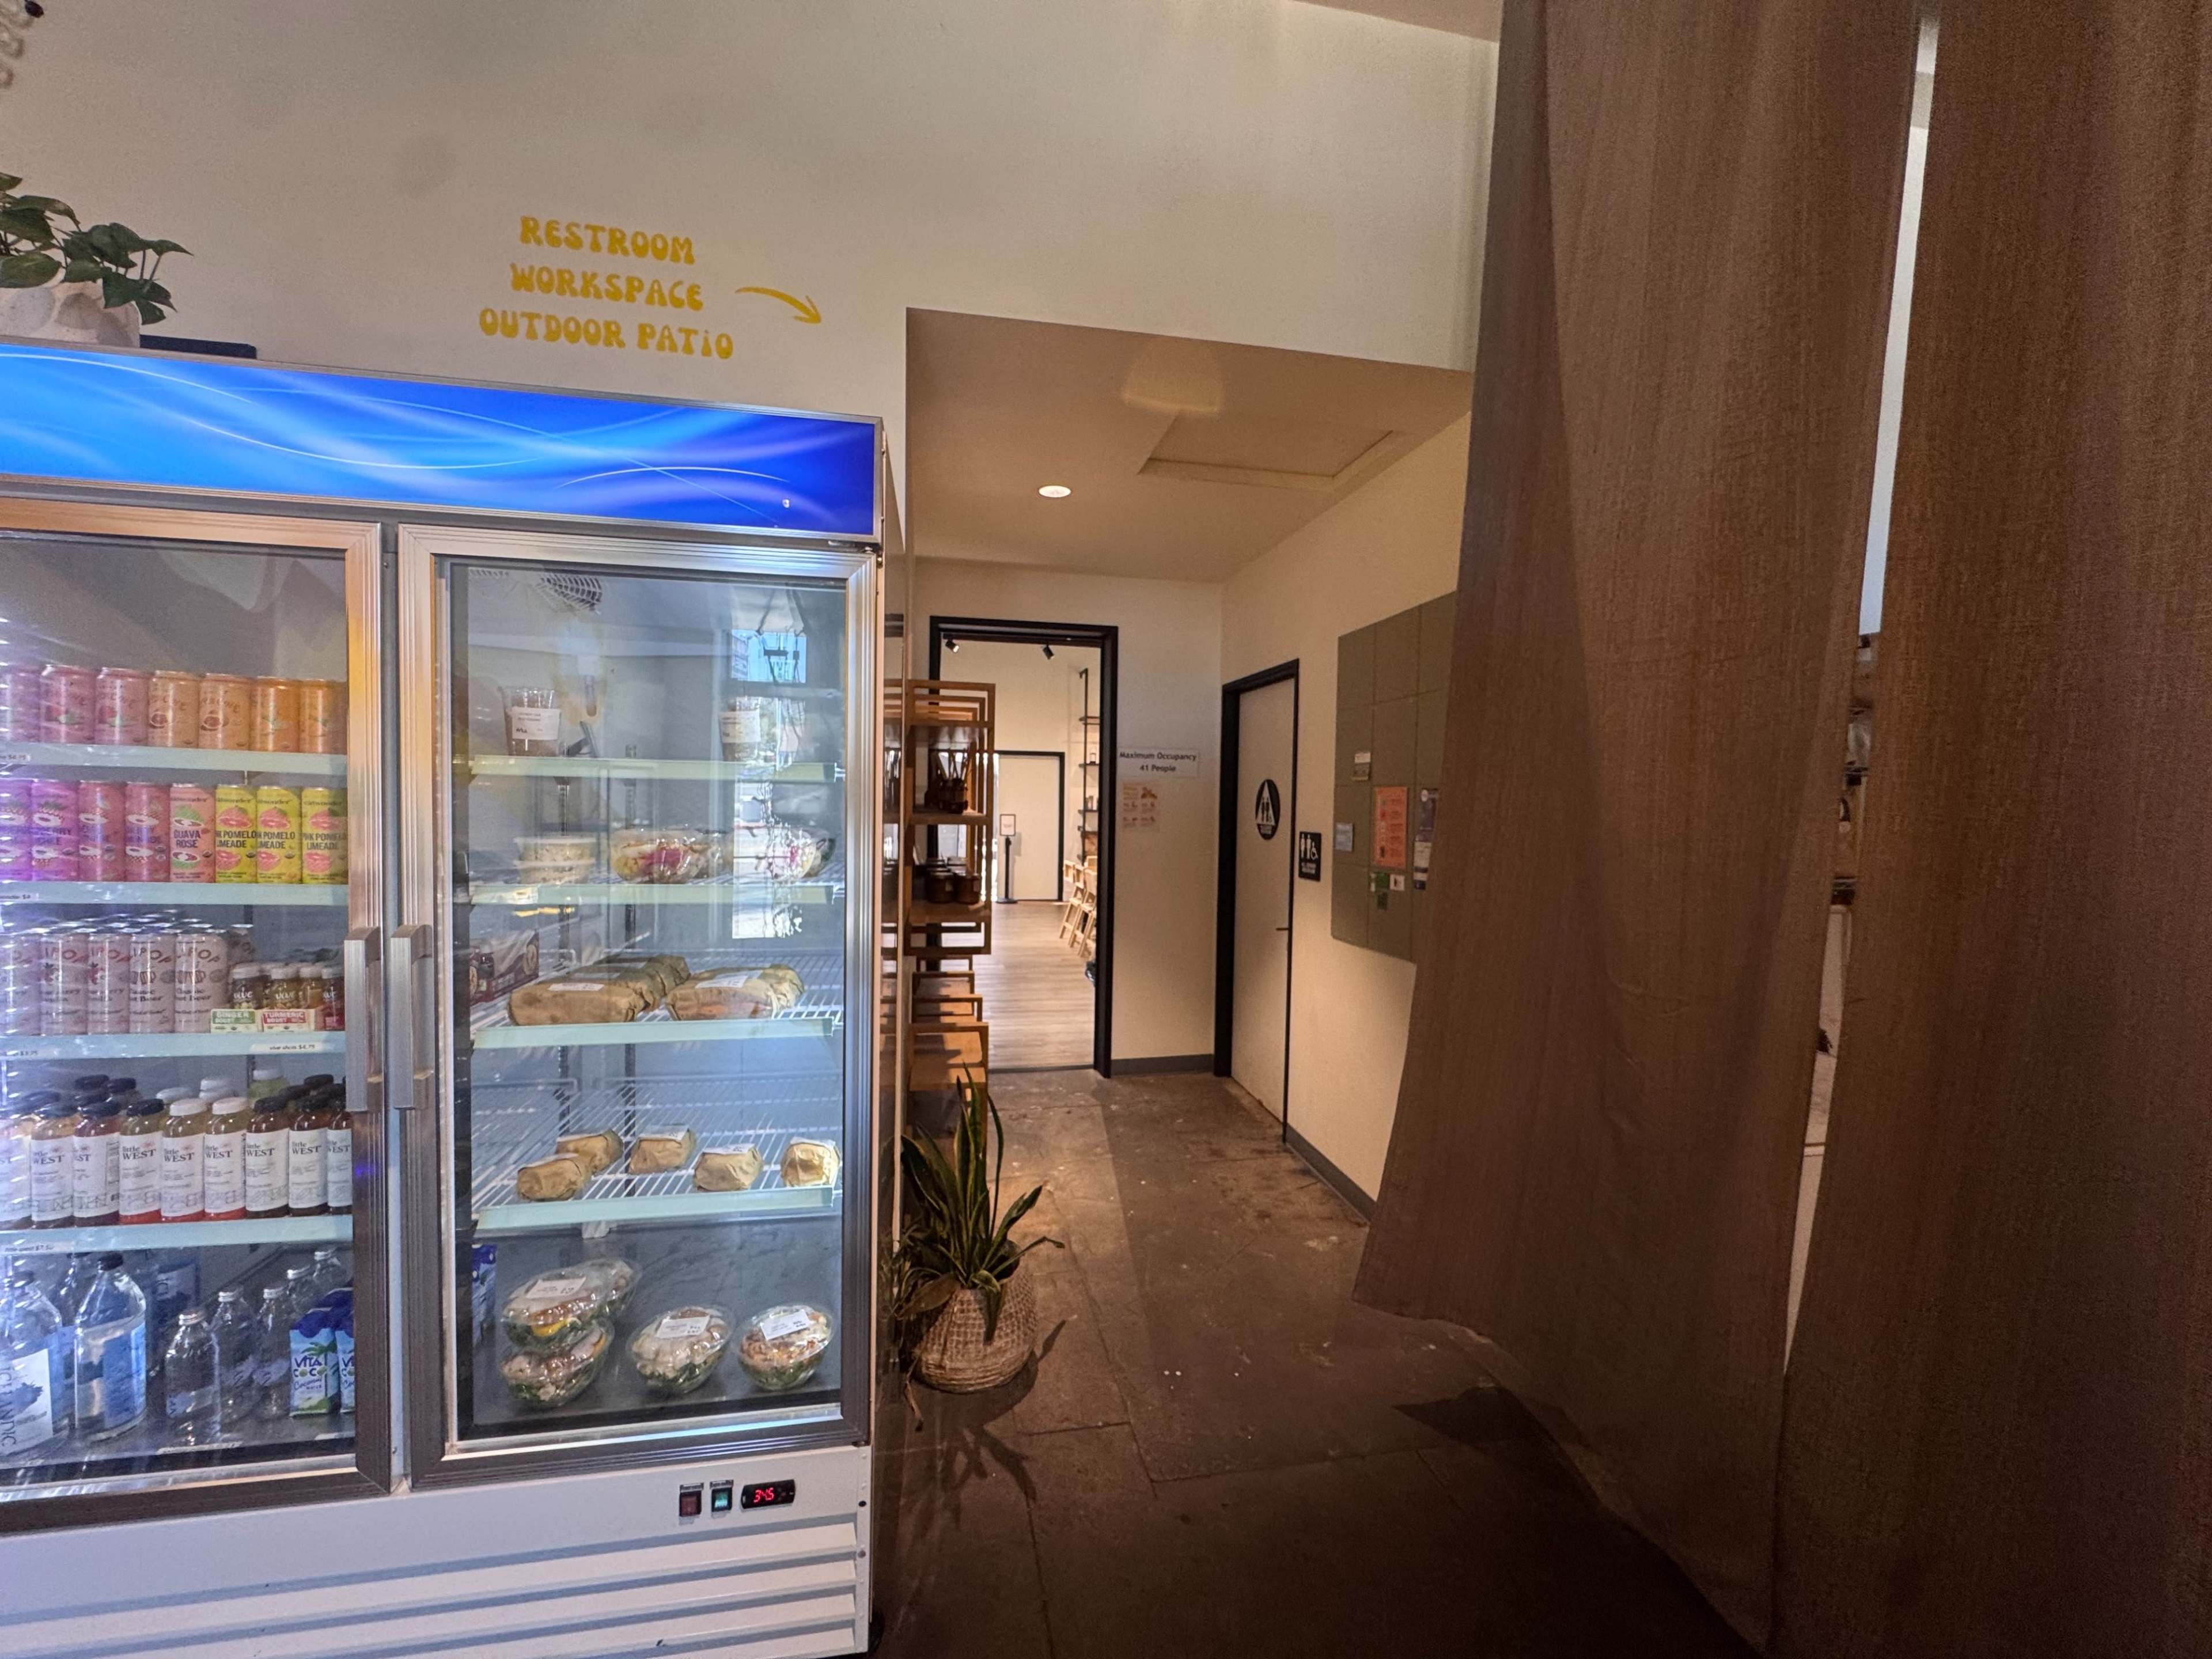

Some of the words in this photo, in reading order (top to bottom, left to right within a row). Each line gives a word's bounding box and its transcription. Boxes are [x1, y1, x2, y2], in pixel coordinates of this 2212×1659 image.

[520, 216, 695, 265] RESTROOM
[510, 263, 703, 311] WORKSPACE
[479, 308, 626, 349] OUTDOOR
[1156, 752, 1197, 762] Occupancy
[1152, 764, 1176, 772] People
[174, 830, 201, 839] GUAVA
[223, 830, 257, 839] POMELO
[263, 831, 296, 840] POMELO
[176, 839, 198, 849] ROSE
[123, 1149, 156, 1160] WEST
[205, 1150, 233, 1159] WEST
[247, 1147, 276, 1157] WEST
[292, 1145, 321, 1155] WEST
[164, 1152, 195, 1162] WEST
[294, 1355, 322, 1368] VITA
